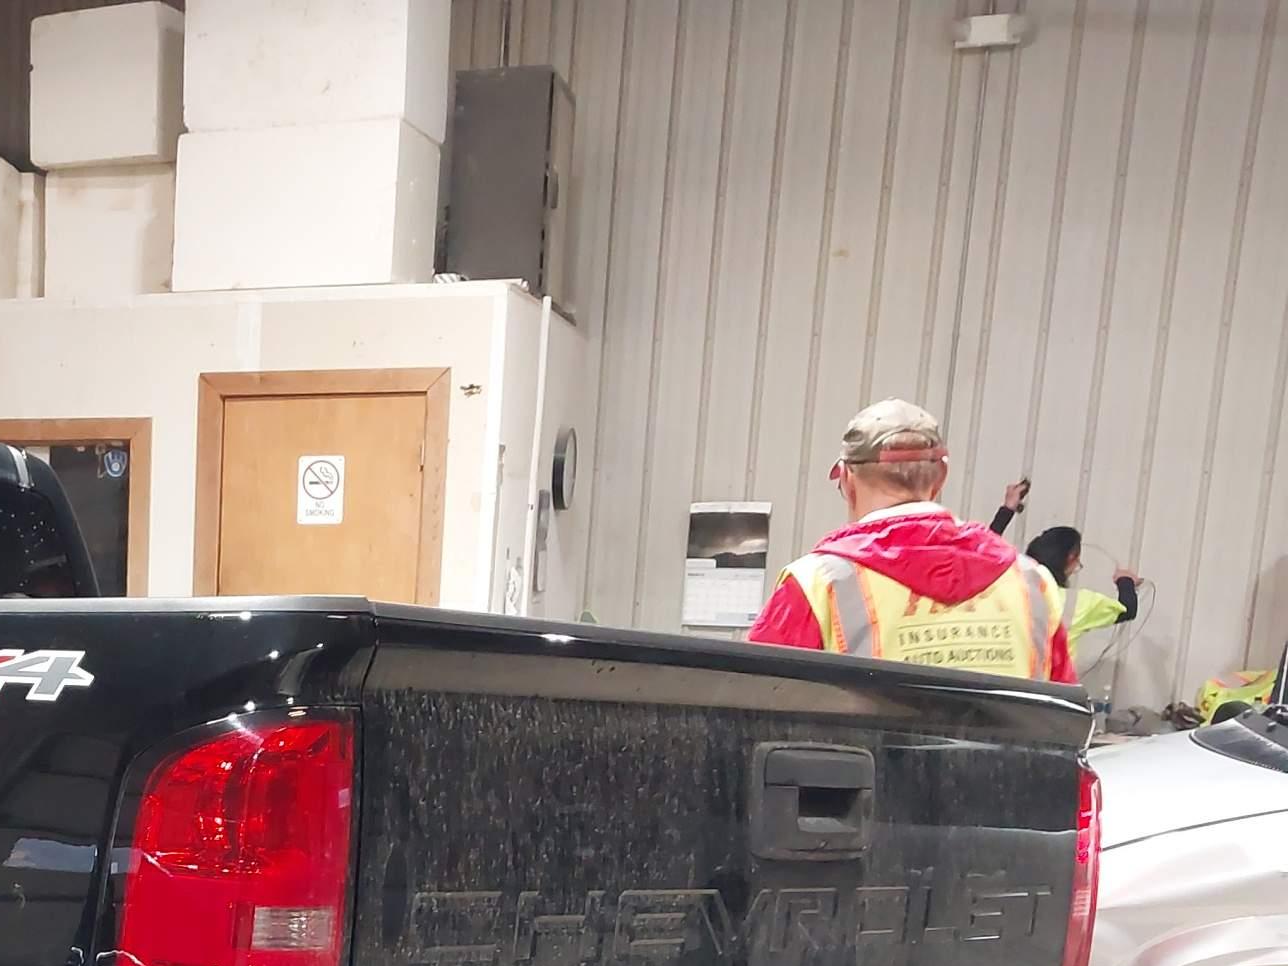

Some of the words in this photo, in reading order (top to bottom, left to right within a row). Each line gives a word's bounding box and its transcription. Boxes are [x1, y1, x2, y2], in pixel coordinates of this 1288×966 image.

[898, 625, 1012, 646] INSURANCE
[946, 648, 1015, 664] AUCTIONS
[409, 884, 1052, 966] CHEVROLET
